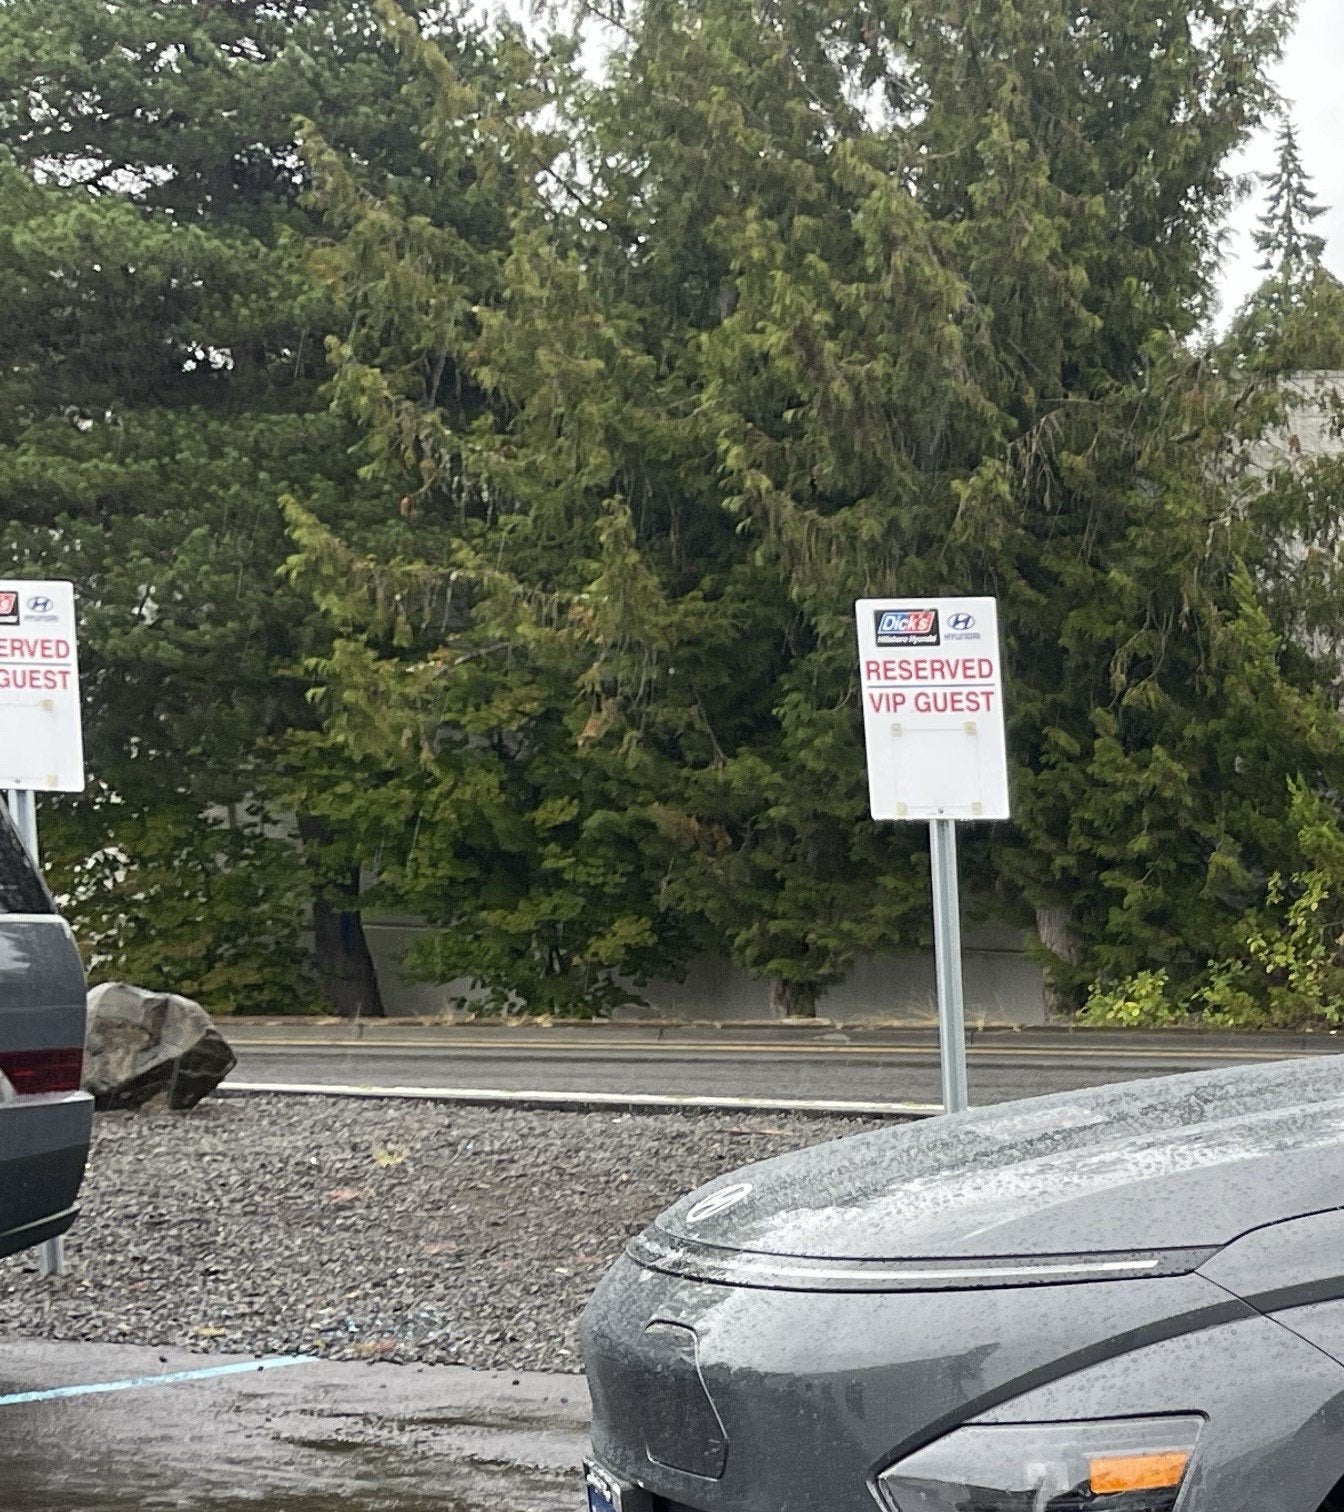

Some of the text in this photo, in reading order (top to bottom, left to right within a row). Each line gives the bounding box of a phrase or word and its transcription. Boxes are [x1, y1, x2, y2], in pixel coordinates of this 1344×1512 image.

[865, 658, 993, 681] RESERVED
[869, 691, 994, 713] VIP GUEST
